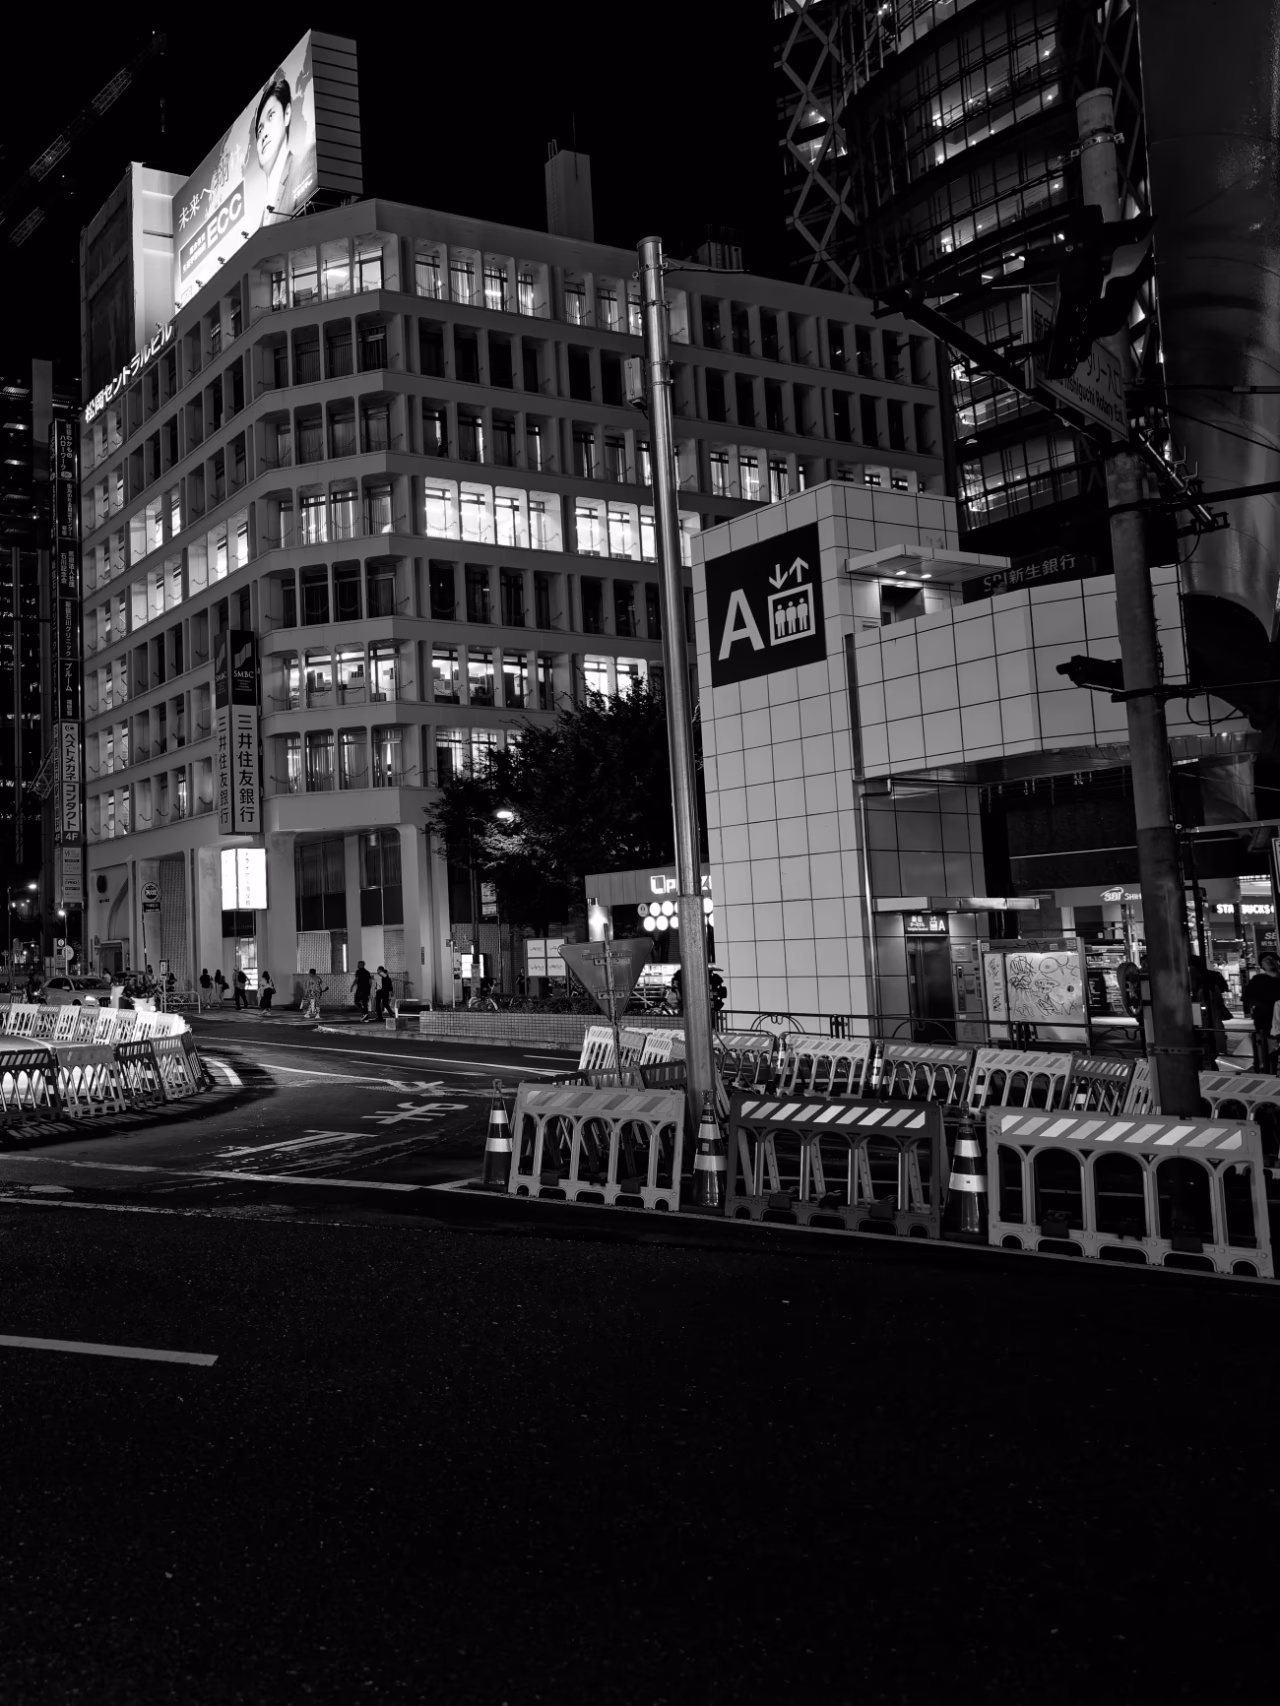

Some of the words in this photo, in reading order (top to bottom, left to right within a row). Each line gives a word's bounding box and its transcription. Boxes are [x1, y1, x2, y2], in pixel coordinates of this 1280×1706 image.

[207, 193, 242, 249] ECC
[718, 588, 766, 661] A
[233, 669, 255, 679] SMBC
[218, 716, 229, 824] 三井住友銀行
[238, 714, 254, 823] 三井住友銀行
[65, 832, 78, 841] 4F
[938, 919, 946, 931] A
[1216, 903, 1271, 915] STABUCKS
